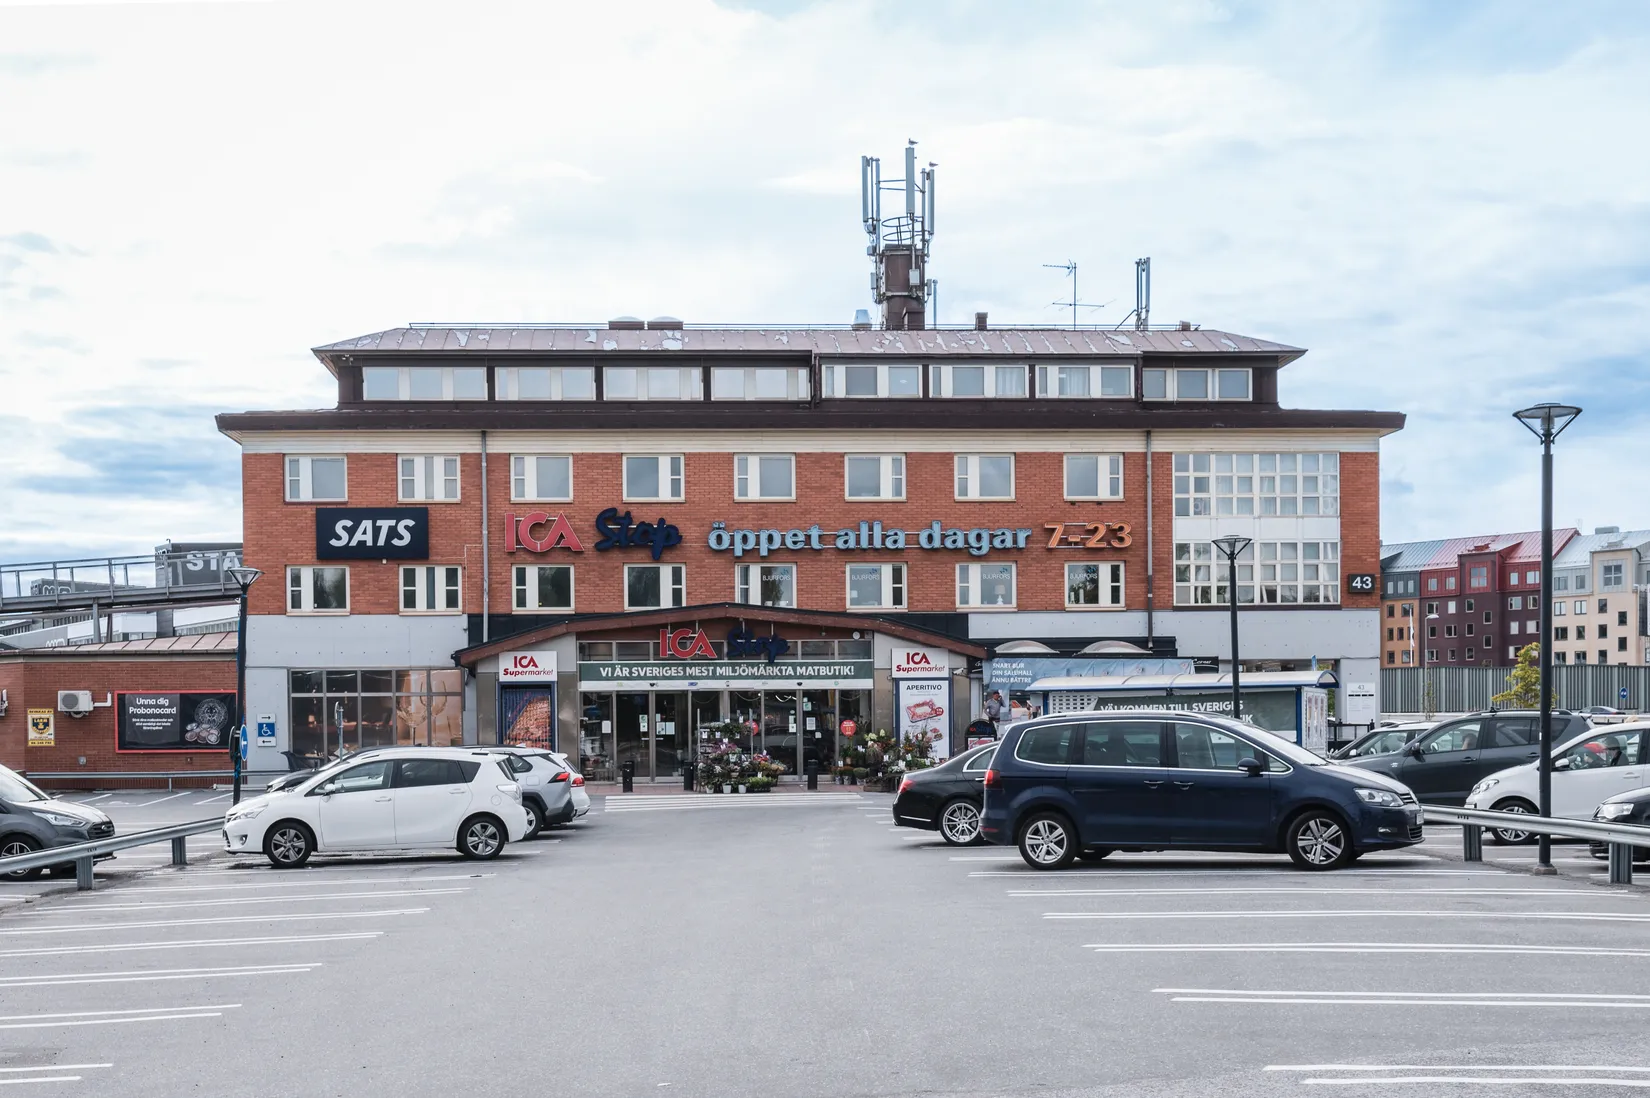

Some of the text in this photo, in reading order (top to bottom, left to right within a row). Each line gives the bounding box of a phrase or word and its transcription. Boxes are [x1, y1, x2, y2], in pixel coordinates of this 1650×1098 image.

[329, 519, 416, 547] SATS
[505, 507, 682, 560] ICA Stop
[707, 520, 1133, 557] öppet alla dagar 7-23
[1352, 576, 1372, 589] 43
[659, 626, 791, 663] ICA Stop
[513, 655, 539, 669] ICA
[906, 652, 931, 665] ICA
[503, 667, 554, 677] Supermarket
[600, 664, 855, 677] VI ÄR SVERIGES MEST MILJÖMÄRKTA MATBUTIK!
[896, 664, 945, 674] Supermarket
[136, 697, 169, 706] Unna dig
[129, 706, 177, 715] Probonocard
